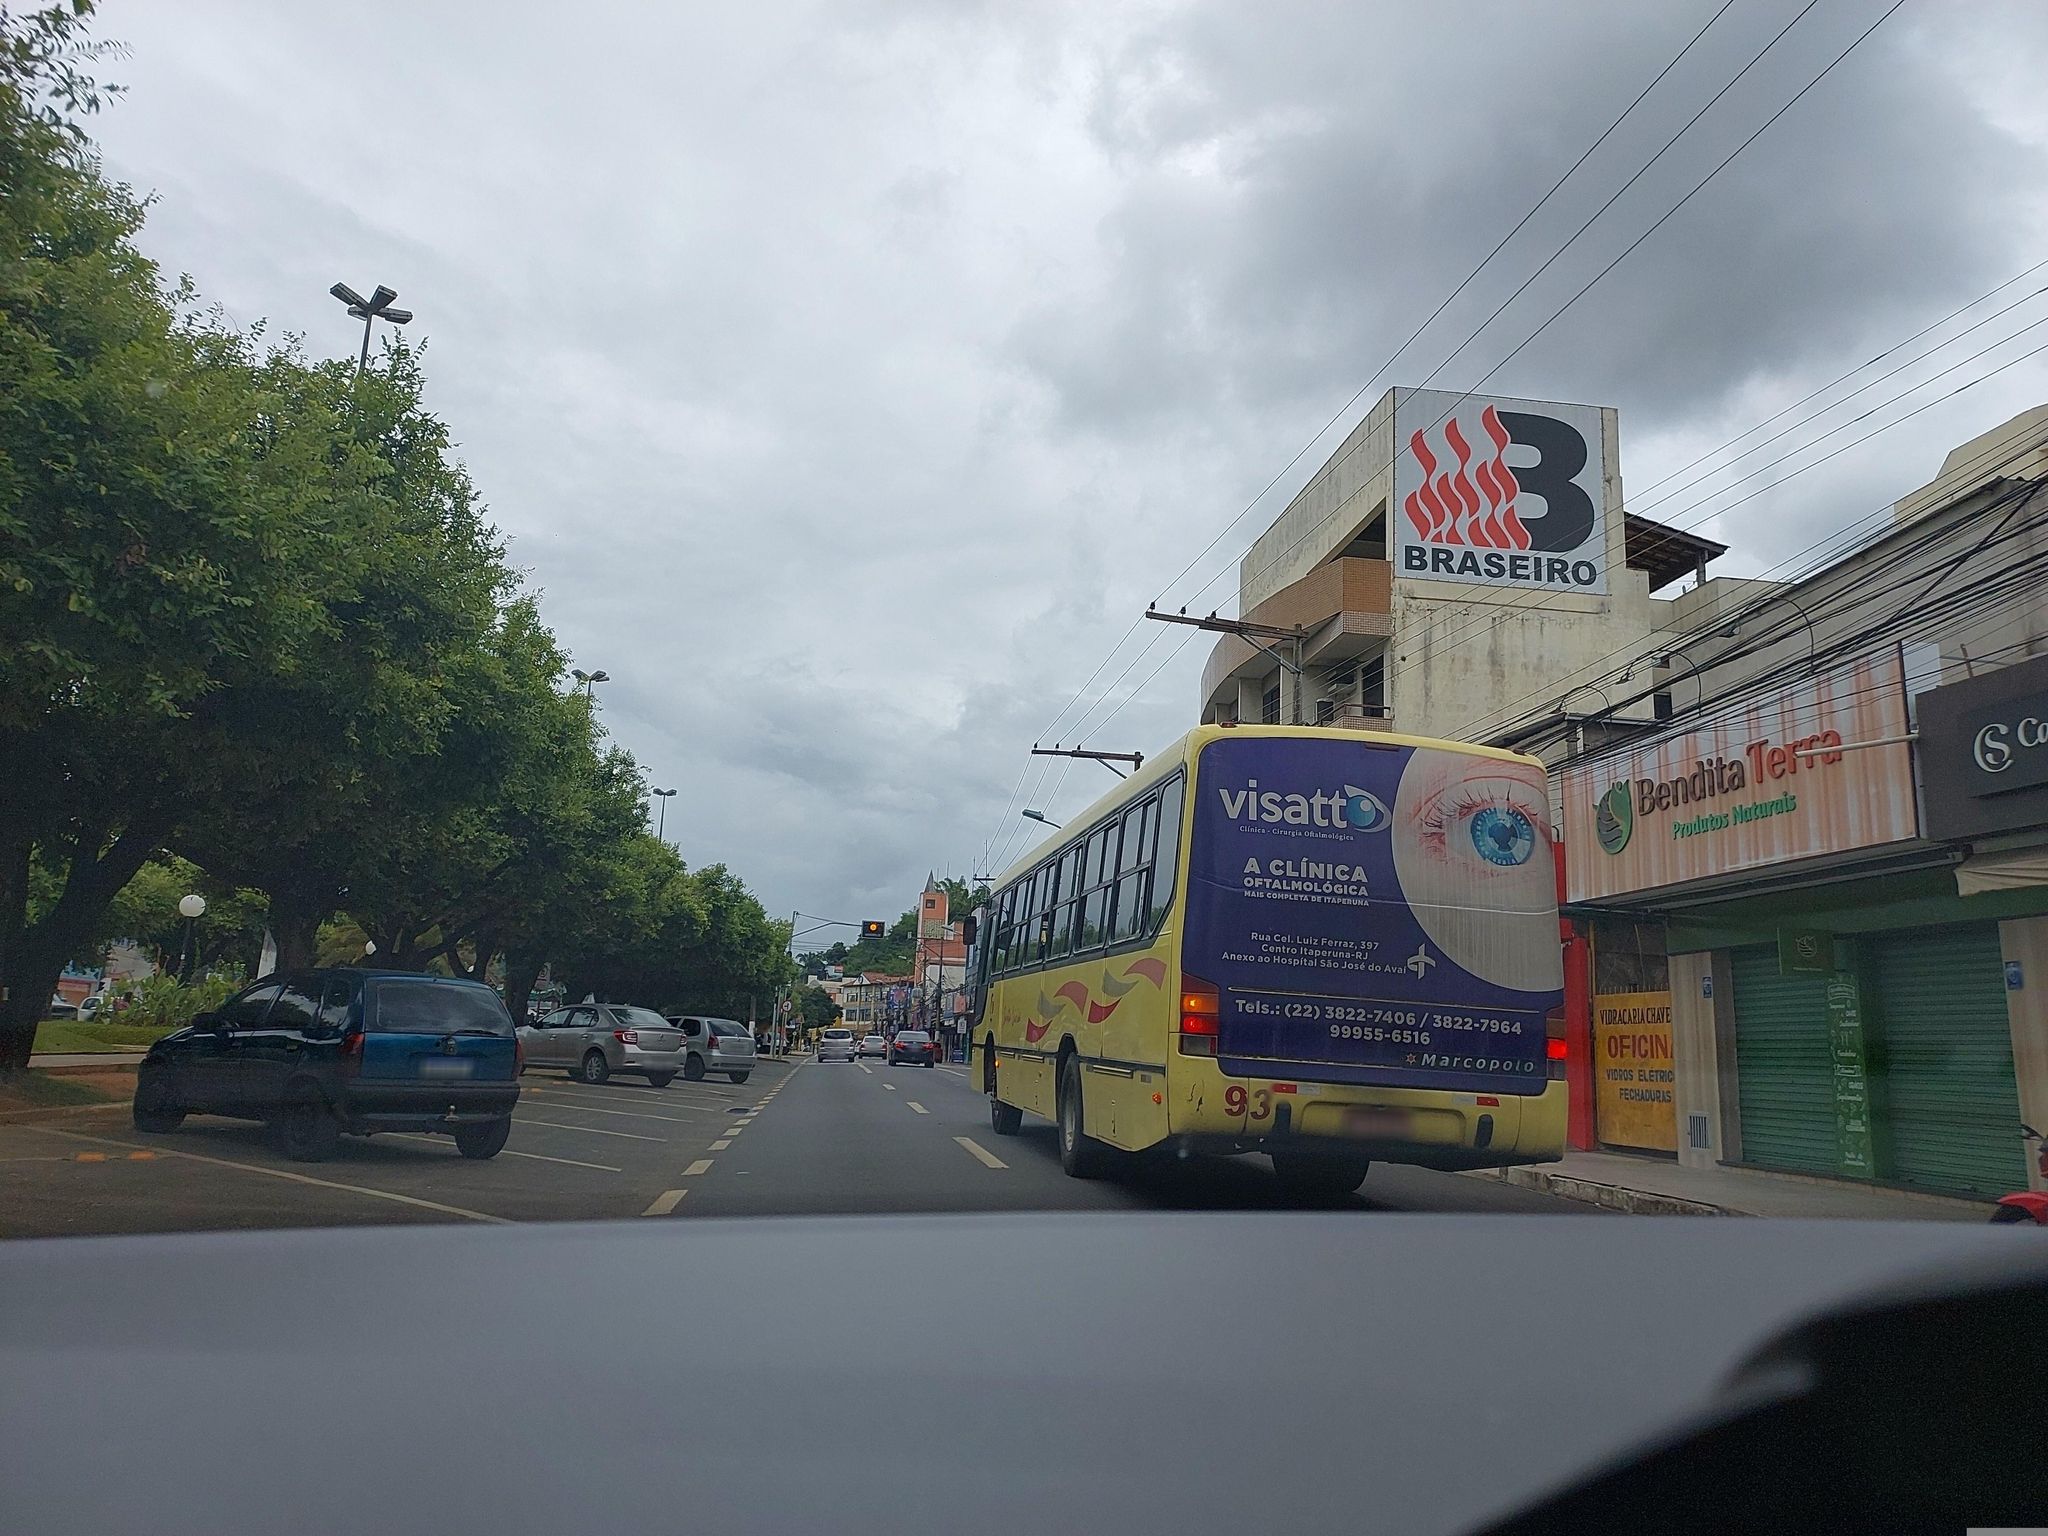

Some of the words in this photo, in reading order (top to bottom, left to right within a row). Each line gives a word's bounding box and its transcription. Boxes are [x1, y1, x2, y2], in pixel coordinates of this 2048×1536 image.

[1404, 545, 1597, 586] BRASEIRO
[1635, 756, 1746, 817] Bendita
[1746, 728, 1843, 784] Terra
[1672, 810, 1730, 841] Produtos
[1732, 791, 1798, 827] Naturais
[1239, 825, 1267, 834] Clínica
[1272, 828, 1303, 839] Cirurgia
[1304, 830, 1354, 842] Oftalmológica
[1243, 857, 1261, 875] A
[1269, 857, 1369, 883] CLÍNICA
[1243, 877, 1369, 897] OFTALMOLÓGICA
[1244, 890, 1265, 898] MAIS
[1266, 892, 1309, 902] COMPLETA
[1311, 895, 1322, 903] DE
[1323, 896, 1370, 907] ITAPERUNA
[1251, 932, 1271, 942] Rua
[1273, 933, 1294, 944] Cel.
[1296, 936, 1319, 946] Luiz
[1321, 938, 1358, 950] Ferraz,
[1360, 941, 1380, 951] 397
[1261, 943, 1298, 955] Centro
[1300, 946, 1369, 960] Itaperuna-RJ
[1221, 952, 1255, 962] Anexo
[1320, 959, 1339, 969] São
[1341, 961, 1366, 971] José
[1368, 963, 1382, 972] do
[1384, 964, 1407, 975] Avaí
[1235, 999, 1281, 1016] Tels.:
[1284, 1004, 1321, 1020] (22)
[1325, 1006, 1416, 1027] 3822-7406
[1419, 1012, 1429, 1028] /
[1432, 1014, 1523, 1036] 3822-7964
[1329, 1025, 1431, 1046] 99955-6516
[1421, 1053, 1535, 1074] Marcopolo
[1606, 1068, 1634, 1081] VIDROS
[1638, 1067, 1674, 1083] ELÉTRIC
[1619, 1087, 1672, 1104] FECHADURAS
